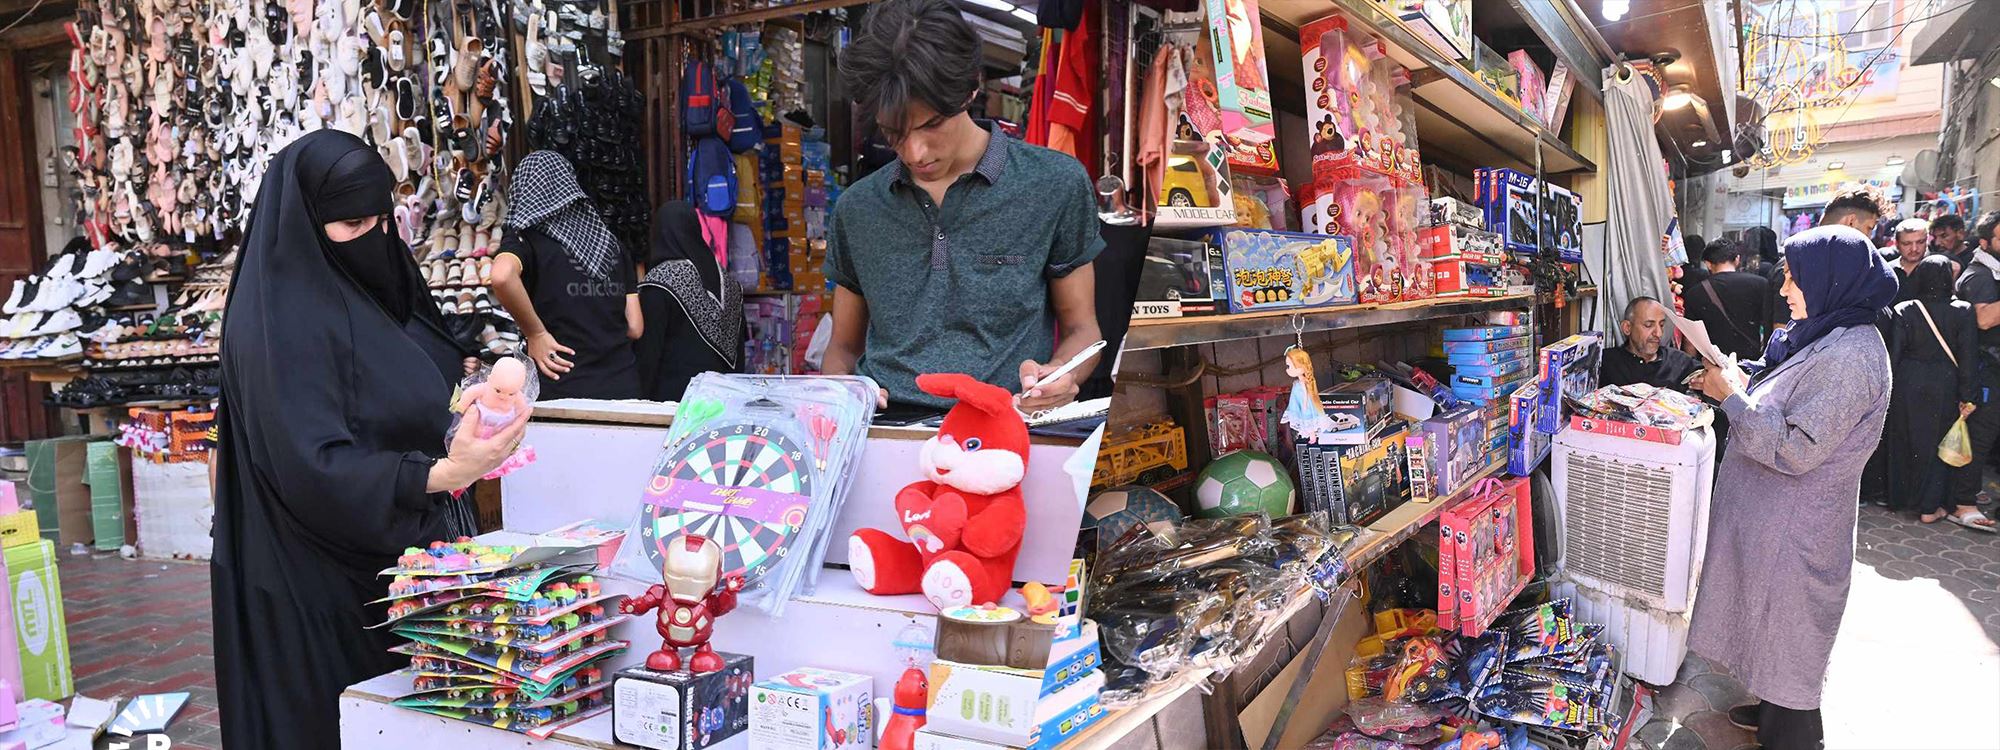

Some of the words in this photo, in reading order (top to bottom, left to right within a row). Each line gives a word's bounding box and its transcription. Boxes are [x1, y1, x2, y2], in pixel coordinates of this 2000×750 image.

[1508, 172, 1529, 189] M-16
[1173, 208, 1213, 219] MODEL
[1215, 209, 1236, 219] CAR
[1142, 305, 1169, 314] TOYS
[734, 425, 744, 434] 5
[753, 426, 769, 436] 20
[709, 431, 719, 440] 12
[778, 436, 785, 445] 1
[687, 442, 696, 451] 9
[791, 450, 802, 461] 18
[1329, 457, 1340, 489] MACHINE
[800, 474, 808, 484] 4
[645, 504, 653, 513] 8
[642, 527, 652, 537] 16
[650, 551, 659, 559] 7
[776, 546, 788, 557] 10
[755, 565, 767, 576] 15
